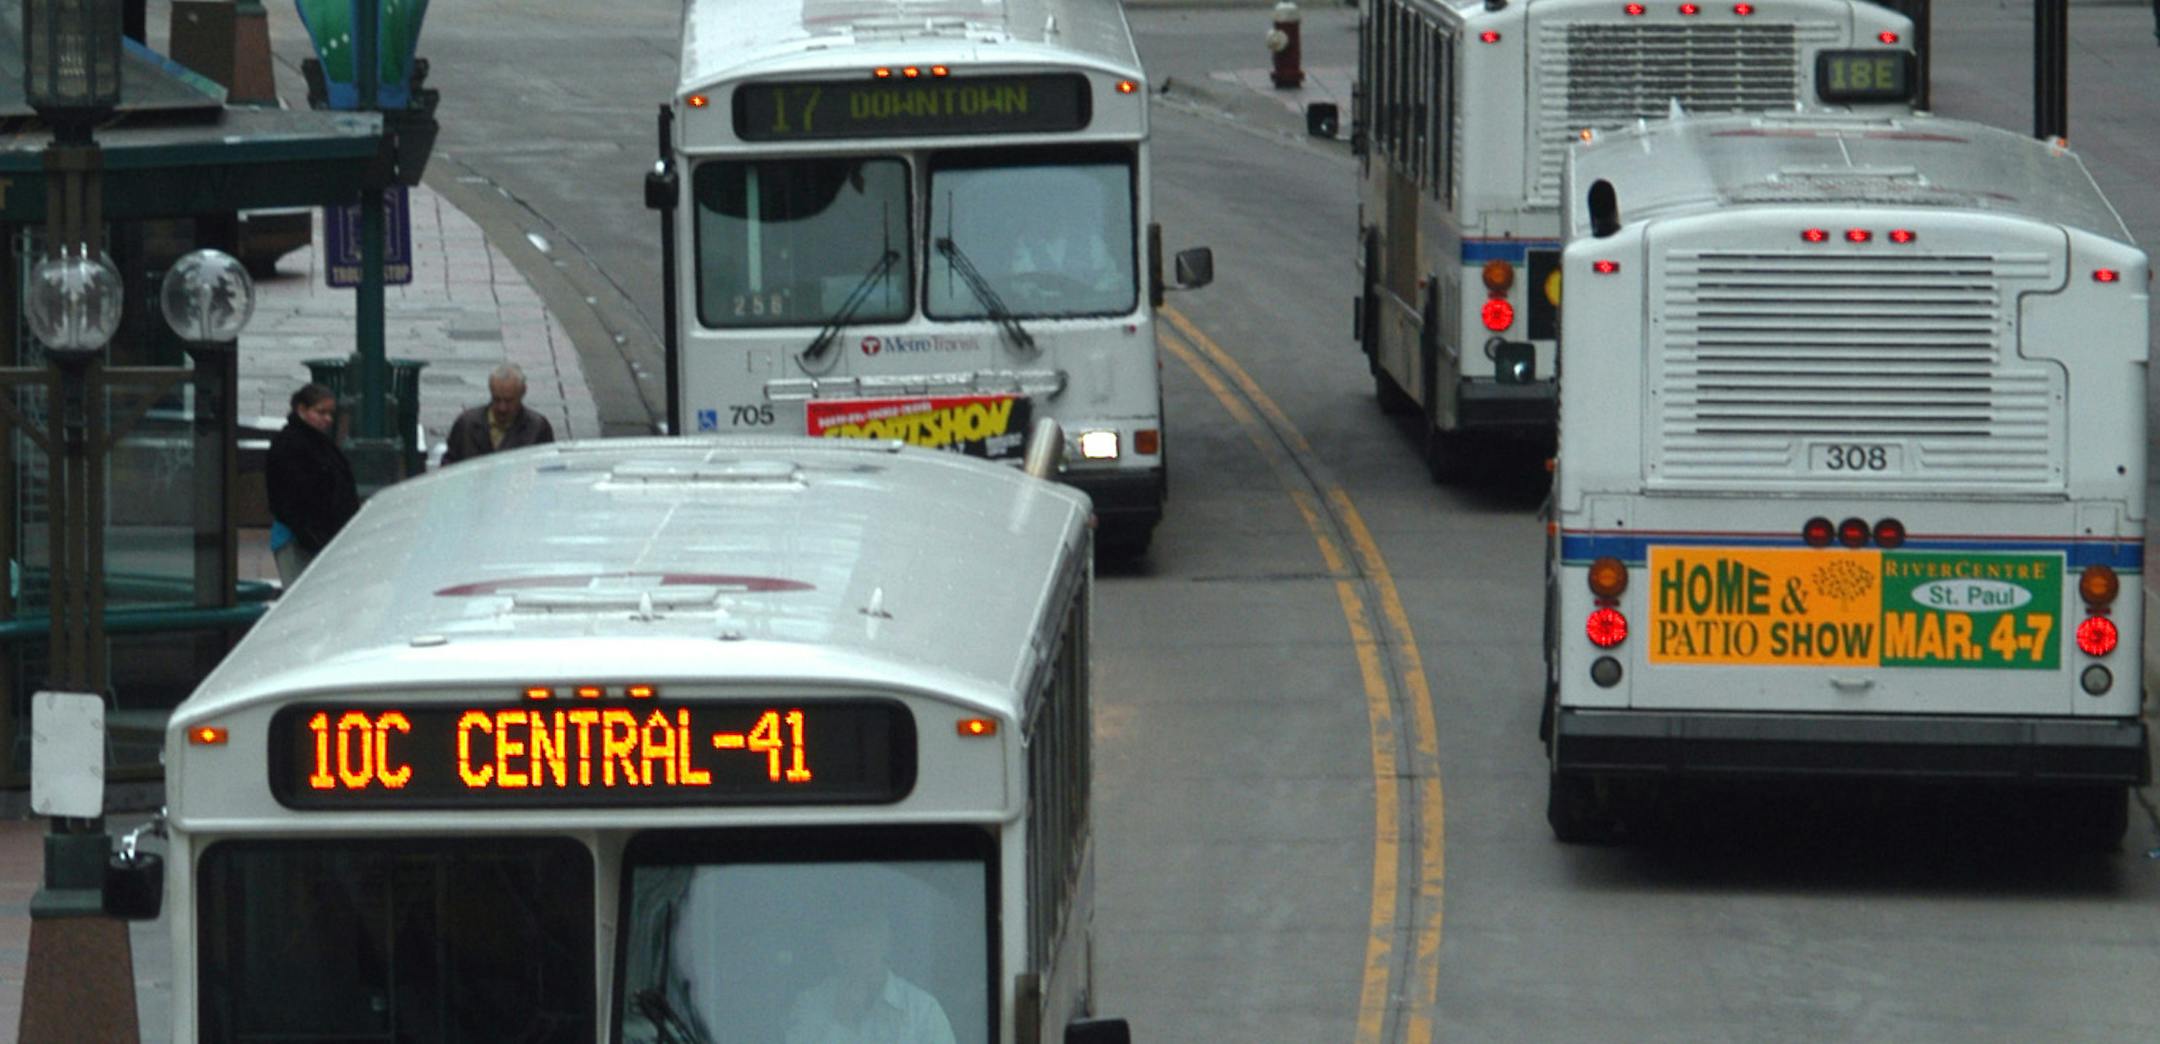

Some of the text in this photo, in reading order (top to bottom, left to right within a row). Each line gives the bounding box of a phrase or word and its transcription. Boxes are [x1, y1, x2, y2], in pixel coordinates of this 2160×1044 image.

[1831, 58, 1896, 90] 18E
[772, 85, 1028, 132] 17 DOWNTOWN
[729, 404, 775, 427] 705
[823, 398, 1013, 448] RTSHOW
[1826, 444, 1887, 471] 308
[1659, 557, 1809, 617] HOME &
[1929, 585, 2015, 607] St. Paul
[1658, 619, 1875, 659] PATIO SHOW
[1884, 611, 2054, 663] MAR. 4-7
[309, 708, 813, 789] 10C CENTRAL-41
